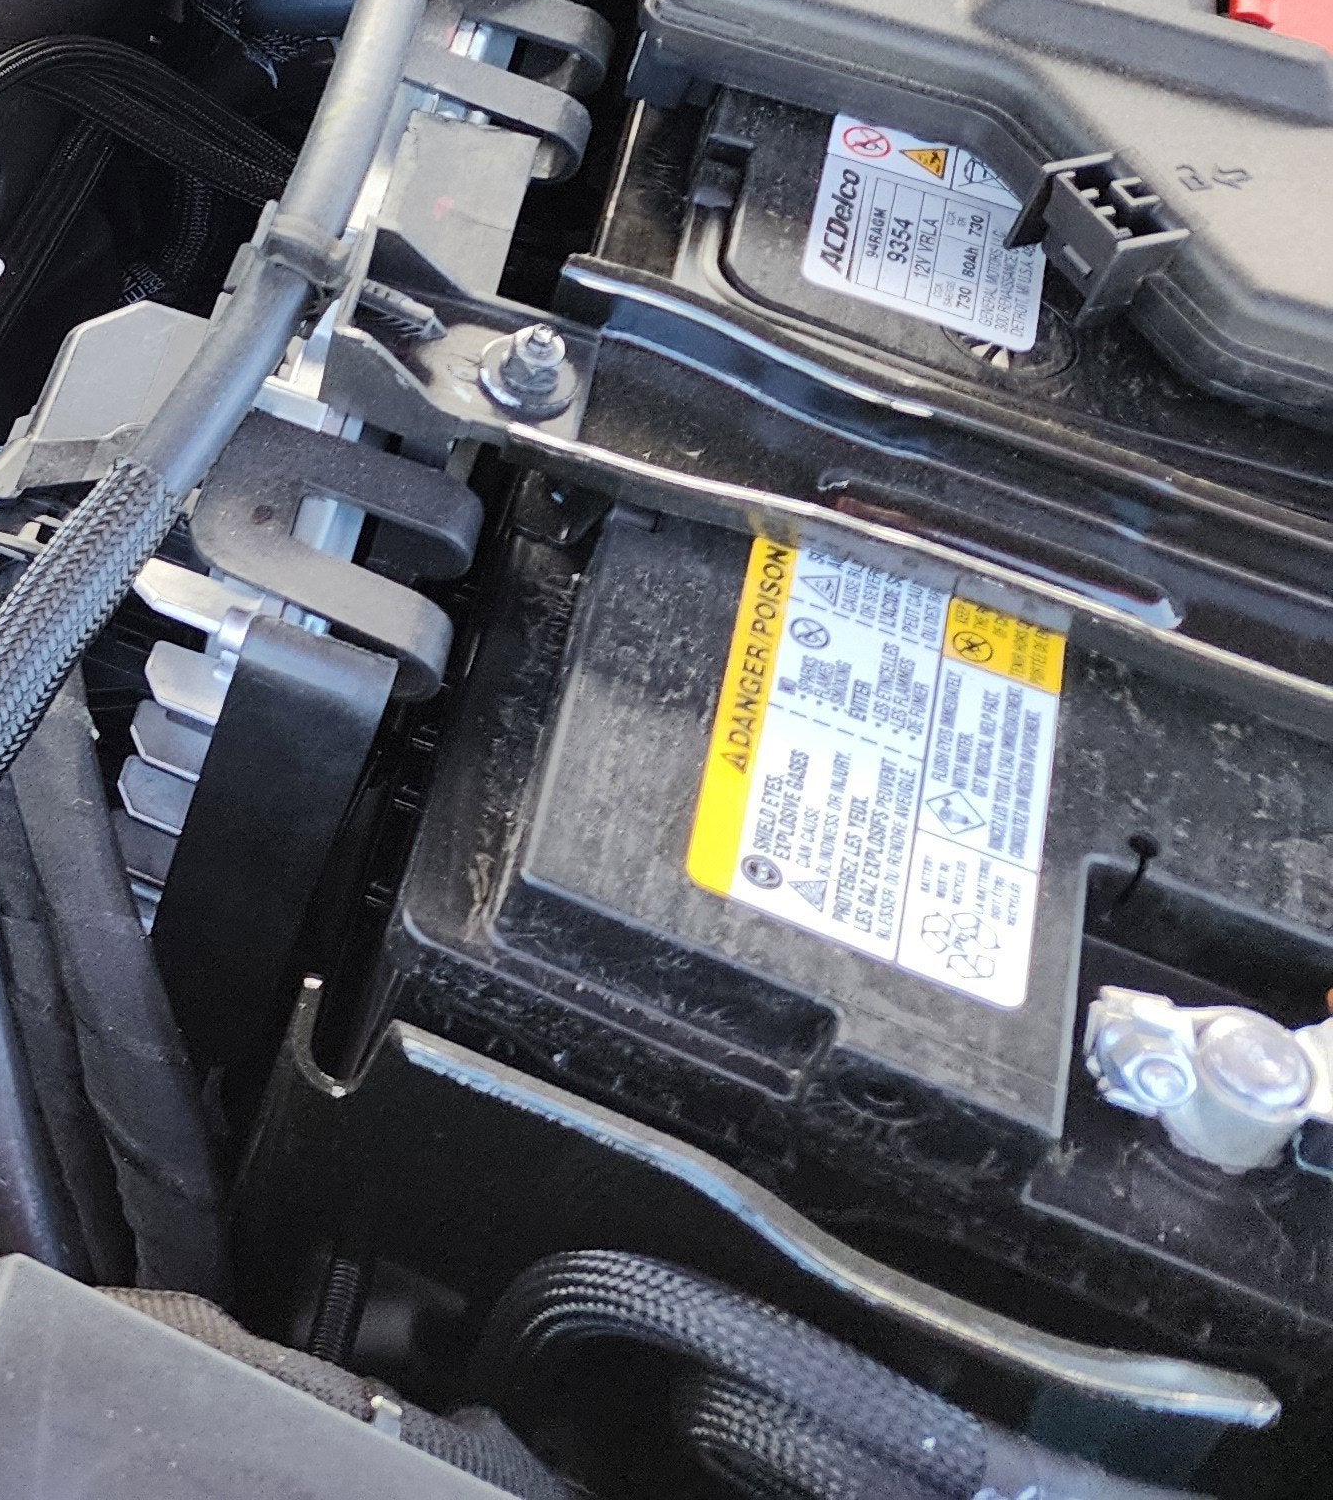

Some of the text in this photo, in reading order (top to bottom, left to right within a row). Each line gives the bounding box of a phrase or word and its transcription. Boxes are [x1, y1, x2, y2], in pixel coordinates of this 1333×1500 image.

[818, 165, 860, 273] ACDelco
[865, 206, 886, 259] 94RAGM
[886, 215, 913, 264] 9354
[968, 213, 984, 238] 730
[913, 215, 938, 279] 12V VRLA
[956, 286, 972, 310] 730
[726, 543, 788, 749] DANGER/POISON
